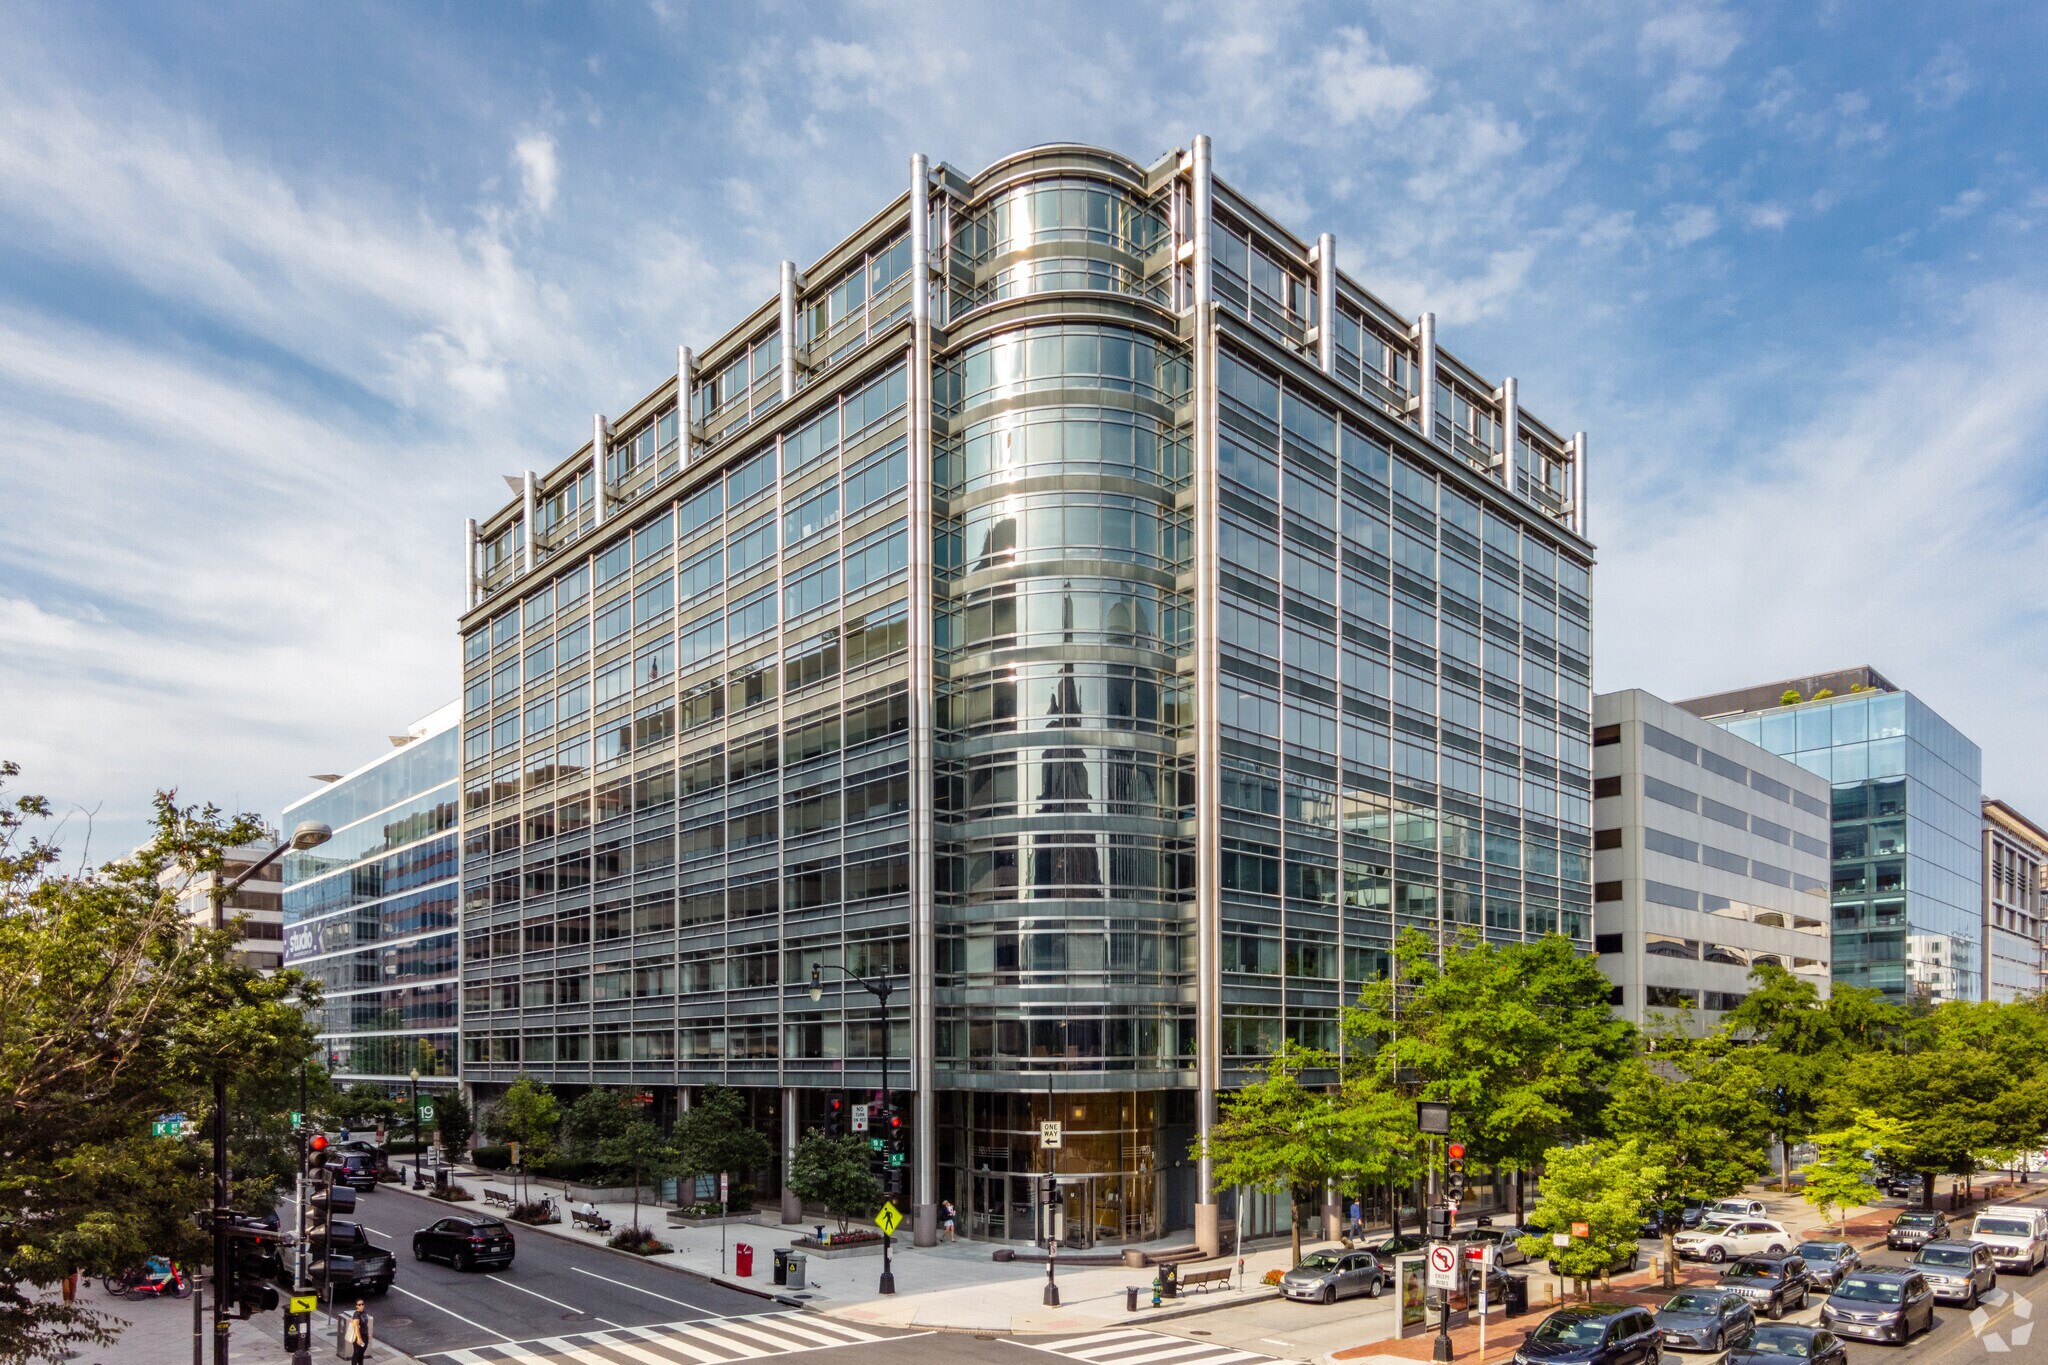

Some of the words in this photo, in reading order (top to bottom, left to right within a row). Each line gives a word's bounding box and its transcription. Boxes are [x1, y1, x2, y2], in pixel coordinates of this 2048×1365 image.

[289, 925, 313, 953] studio
[418, 1106, 434, 1119] 19
[157, 1124, 167, 1134] K
